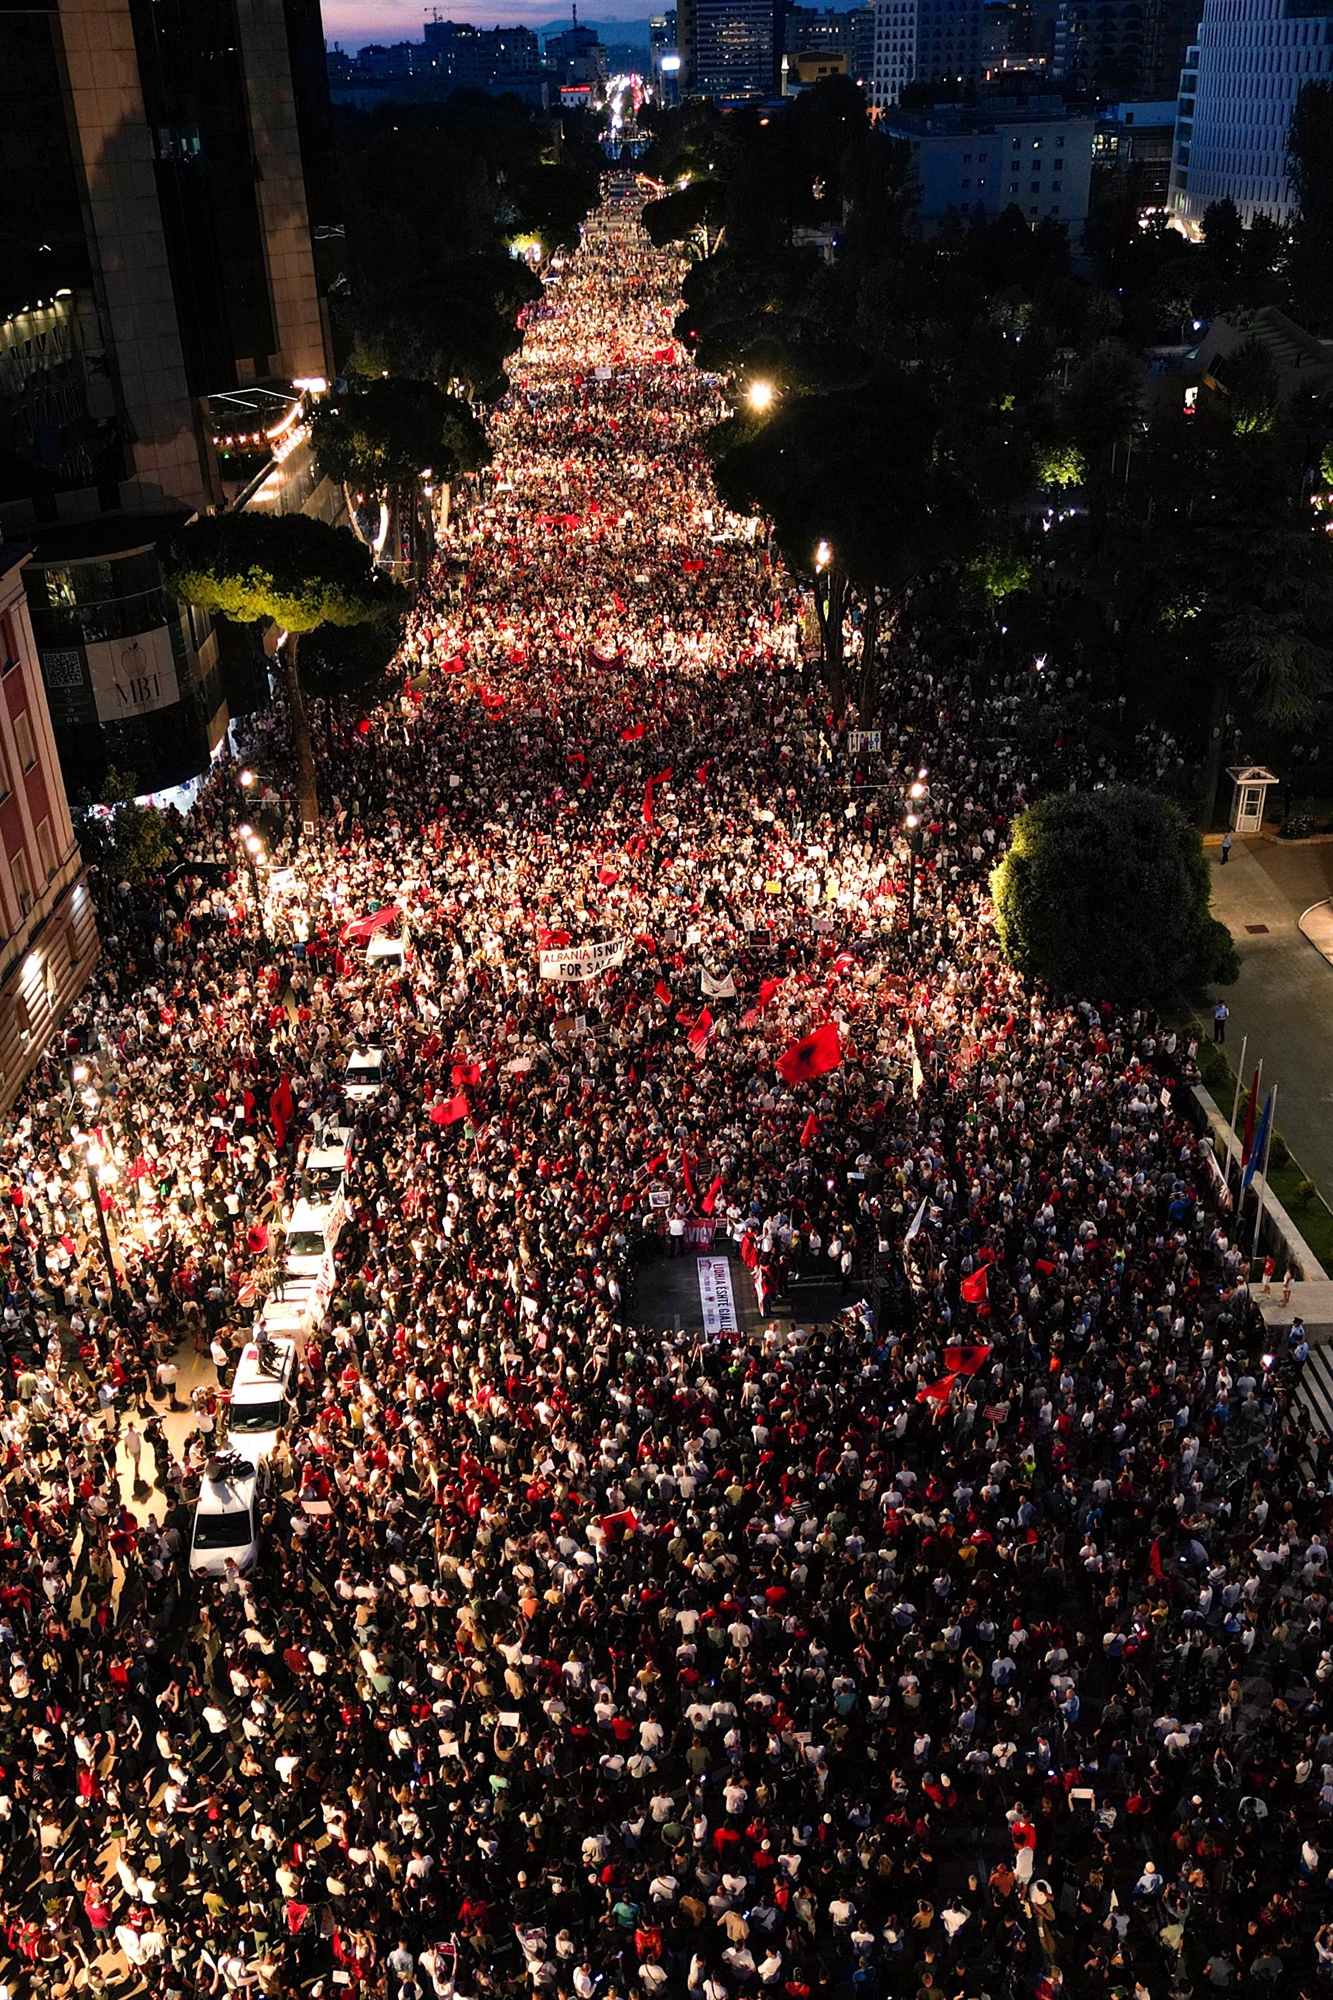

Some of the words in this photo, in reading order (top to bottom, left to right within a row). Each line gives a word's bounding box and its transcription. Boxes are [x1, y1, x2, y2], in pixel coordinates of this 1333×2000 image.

[115, 672, 162, 704] MBT
[543, 949, 591, 964] ALBANIA
[593, 946, 603, 958] IS
[605, 940, 625, 956] NOT
[559, 963, 583, 977] FOR
[712, 1263, 726, 1286] LIDHJA
